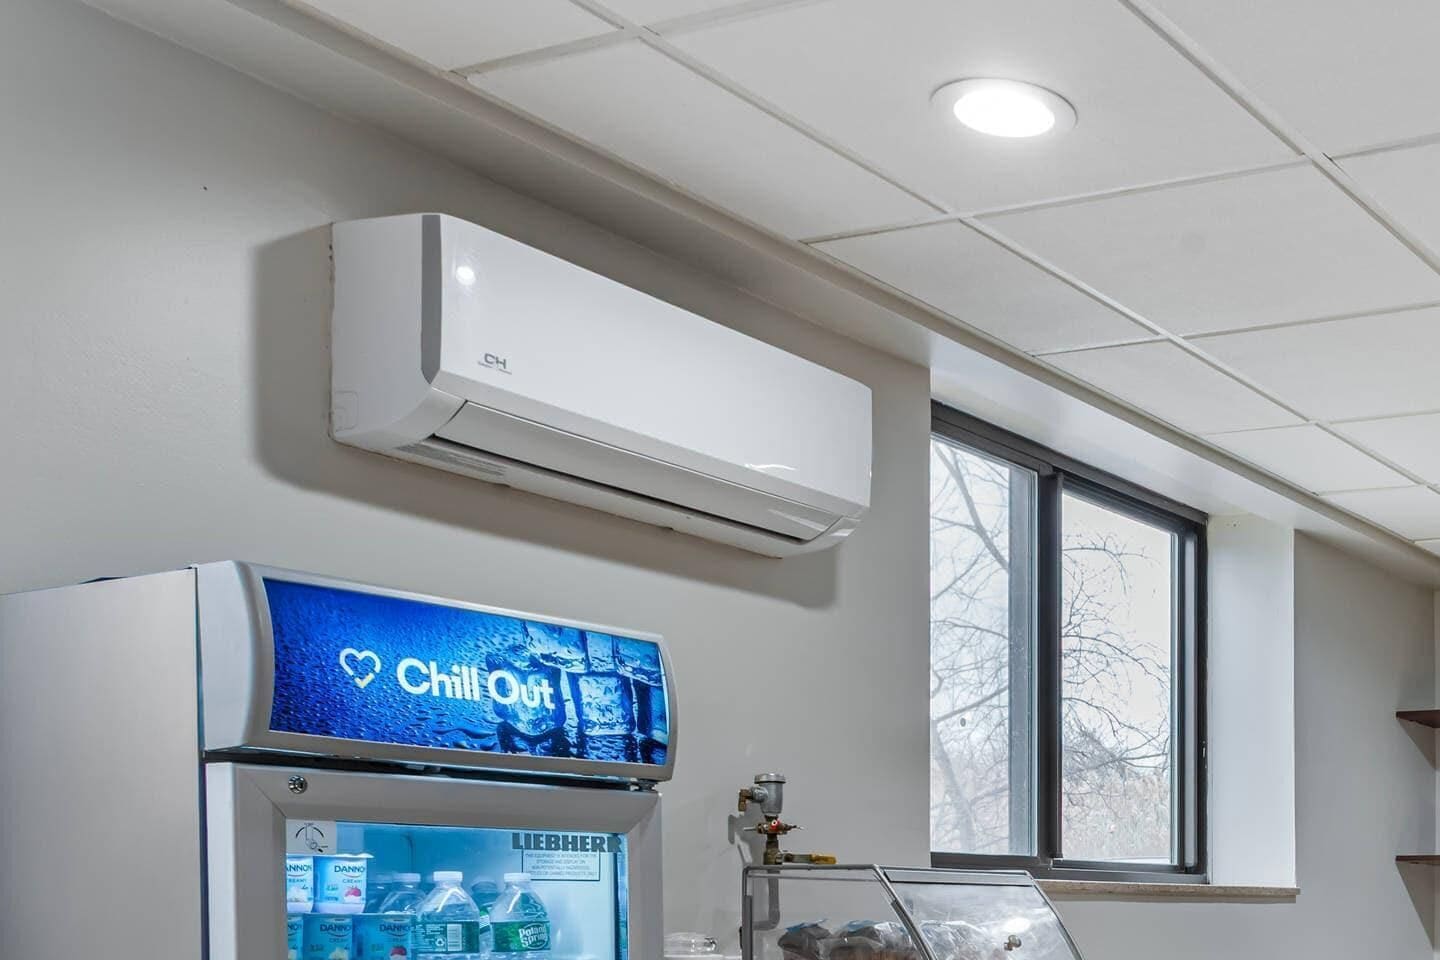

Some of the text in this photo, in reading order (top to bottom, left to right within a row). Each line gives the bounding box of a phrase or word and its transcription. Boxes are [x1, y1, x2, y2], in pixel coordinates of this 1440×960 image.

[397, 657, 555, 710] Chill Out
[512, 833, 622, 853] LIEBHERR
